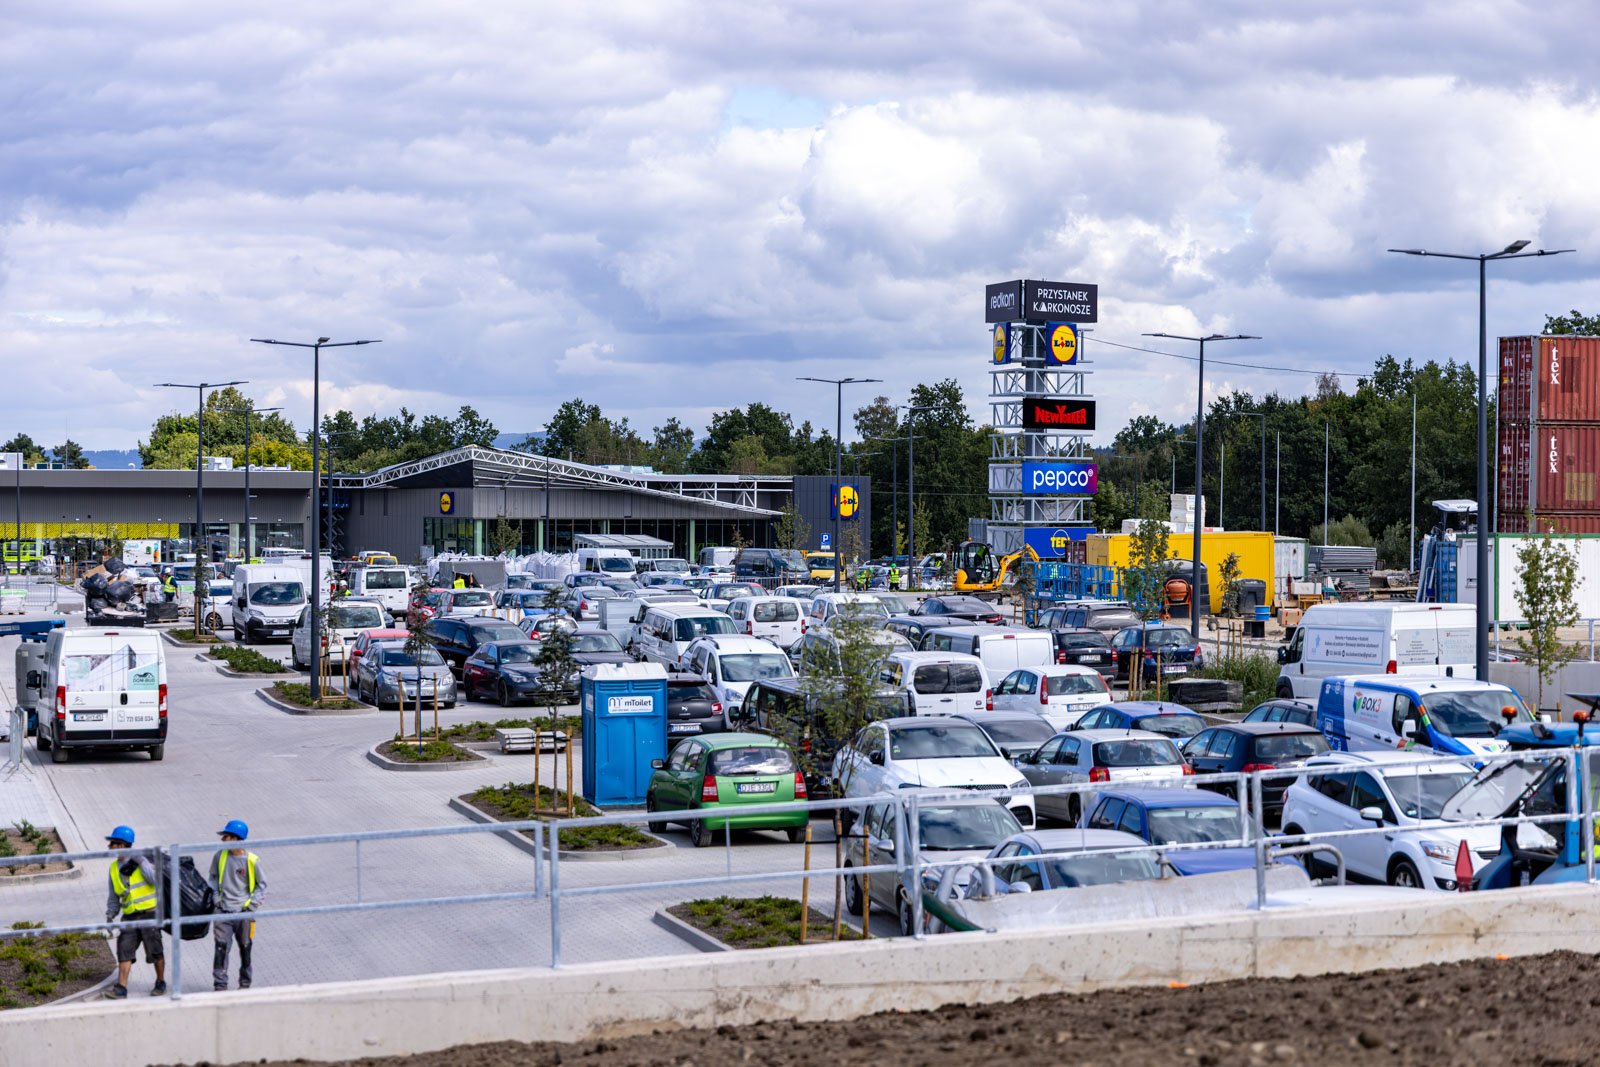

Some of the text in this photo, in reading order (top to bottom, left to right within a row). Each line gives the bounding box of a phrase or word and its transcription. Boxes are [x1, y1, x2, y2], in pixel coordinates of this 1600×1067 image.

[991, 292, 1015, 309] redkom
[1037, 288, 1088, 301] PRZYSTANEK
[1033, 301, 1091, 315] KARKONOSZE
[1550, 346, 1560, 385] tex
[1549, 435, 1559, 473] tex
[822, 534, 829, 543] P
[624, 698, 652, 707] mToilet
